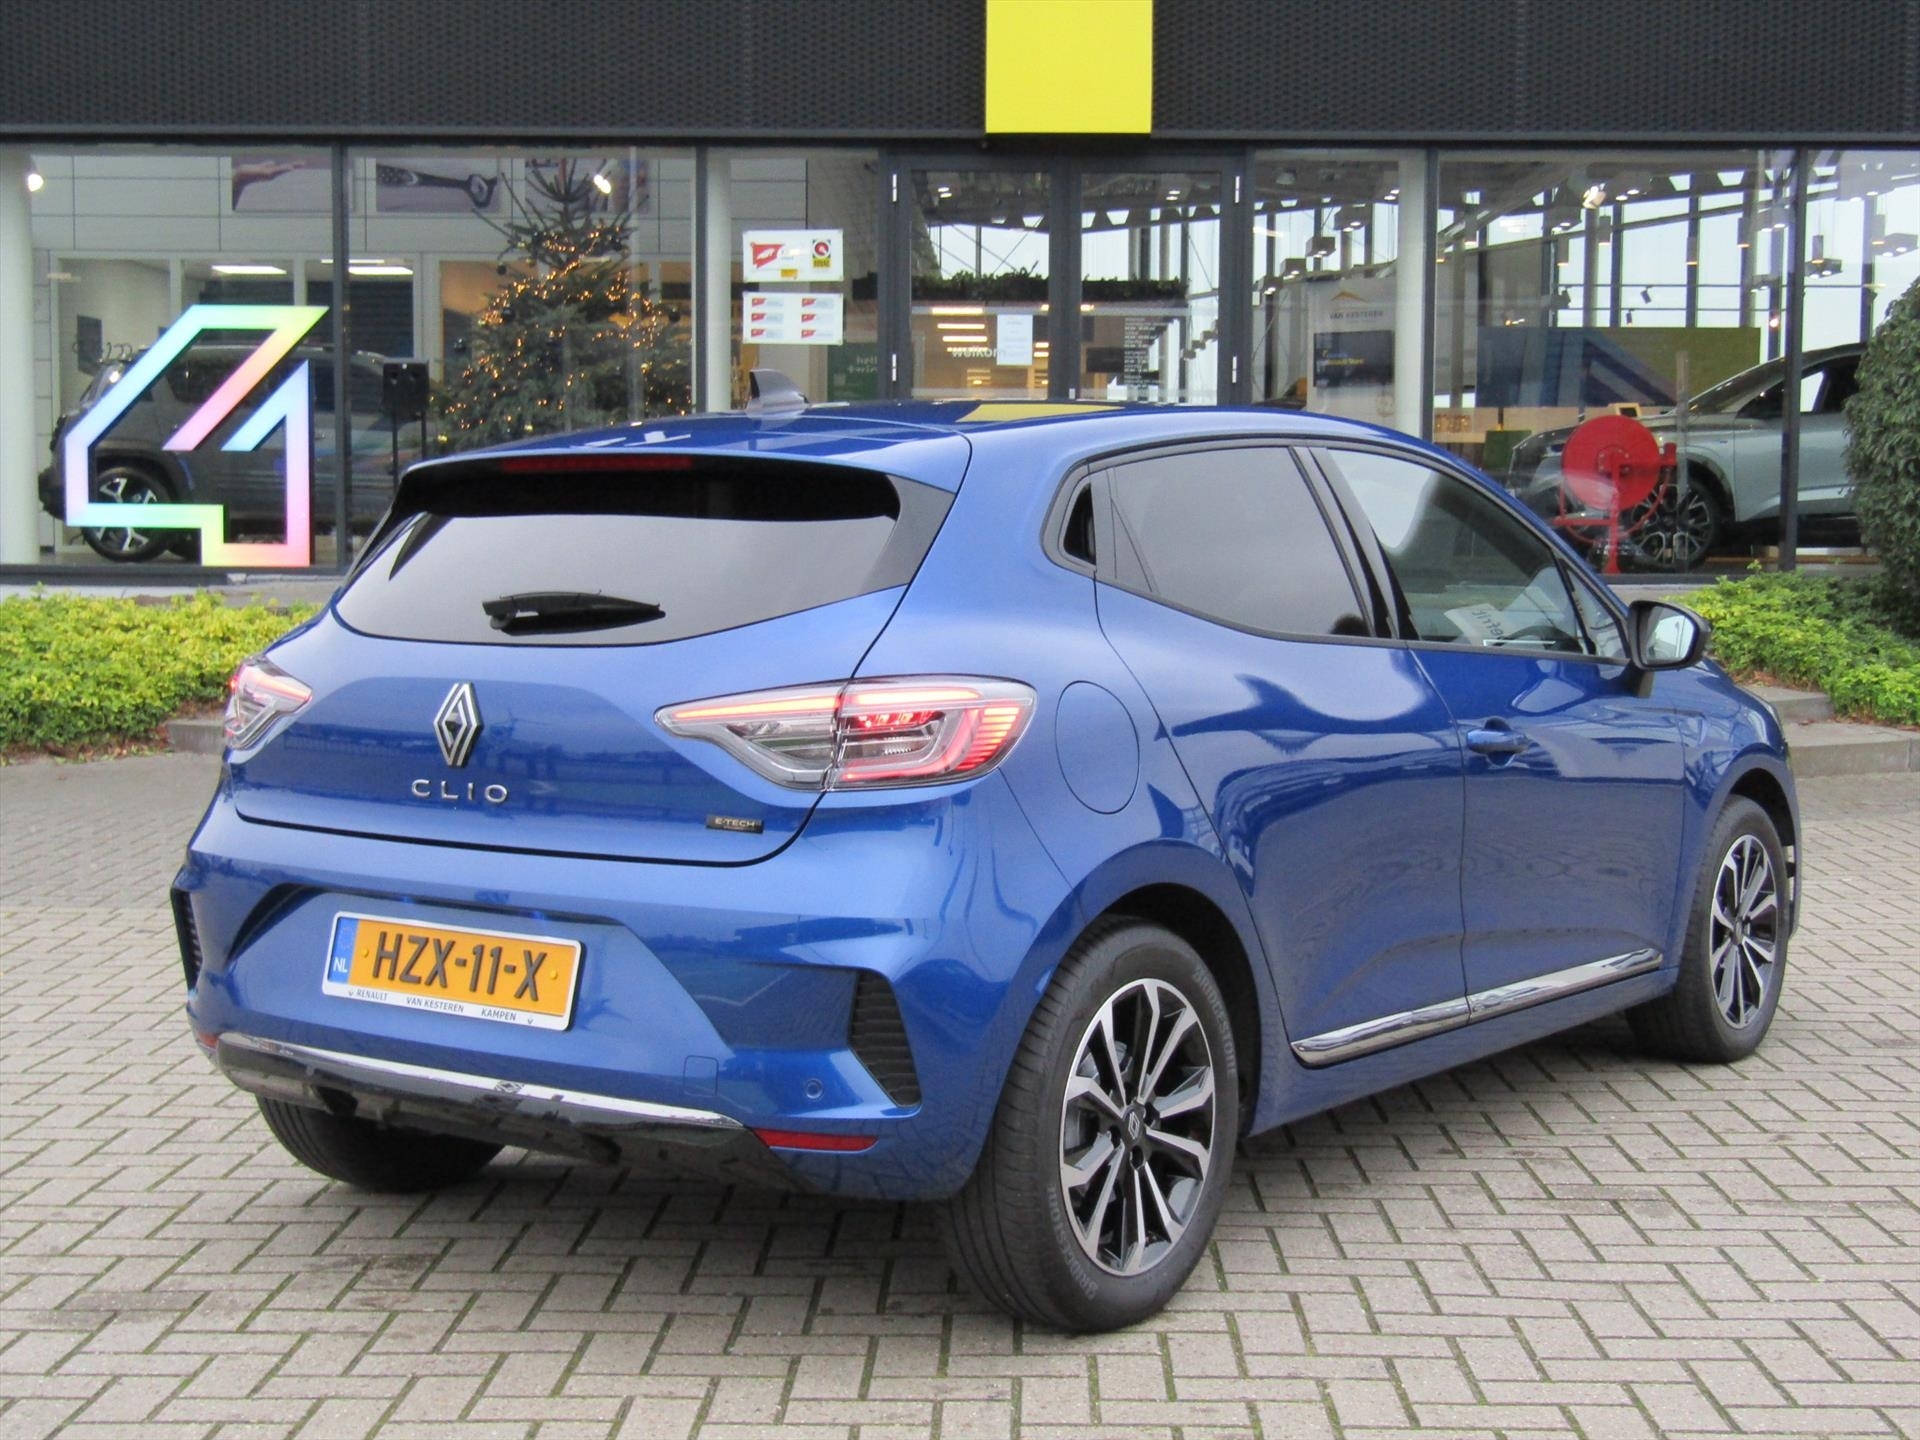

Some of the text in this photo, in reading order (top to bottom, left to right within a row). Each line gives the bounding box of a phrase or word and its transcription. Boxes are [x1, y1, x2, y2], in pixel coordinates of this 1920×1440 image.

[411, 778, 508, 803] CLIO
[333, 956, 348, 974] NL
[372, 931, 547, 1002] HZX-11-X
[356, 988, 517, 1021] RENAULT VAN KESTEREN KAMPEN
